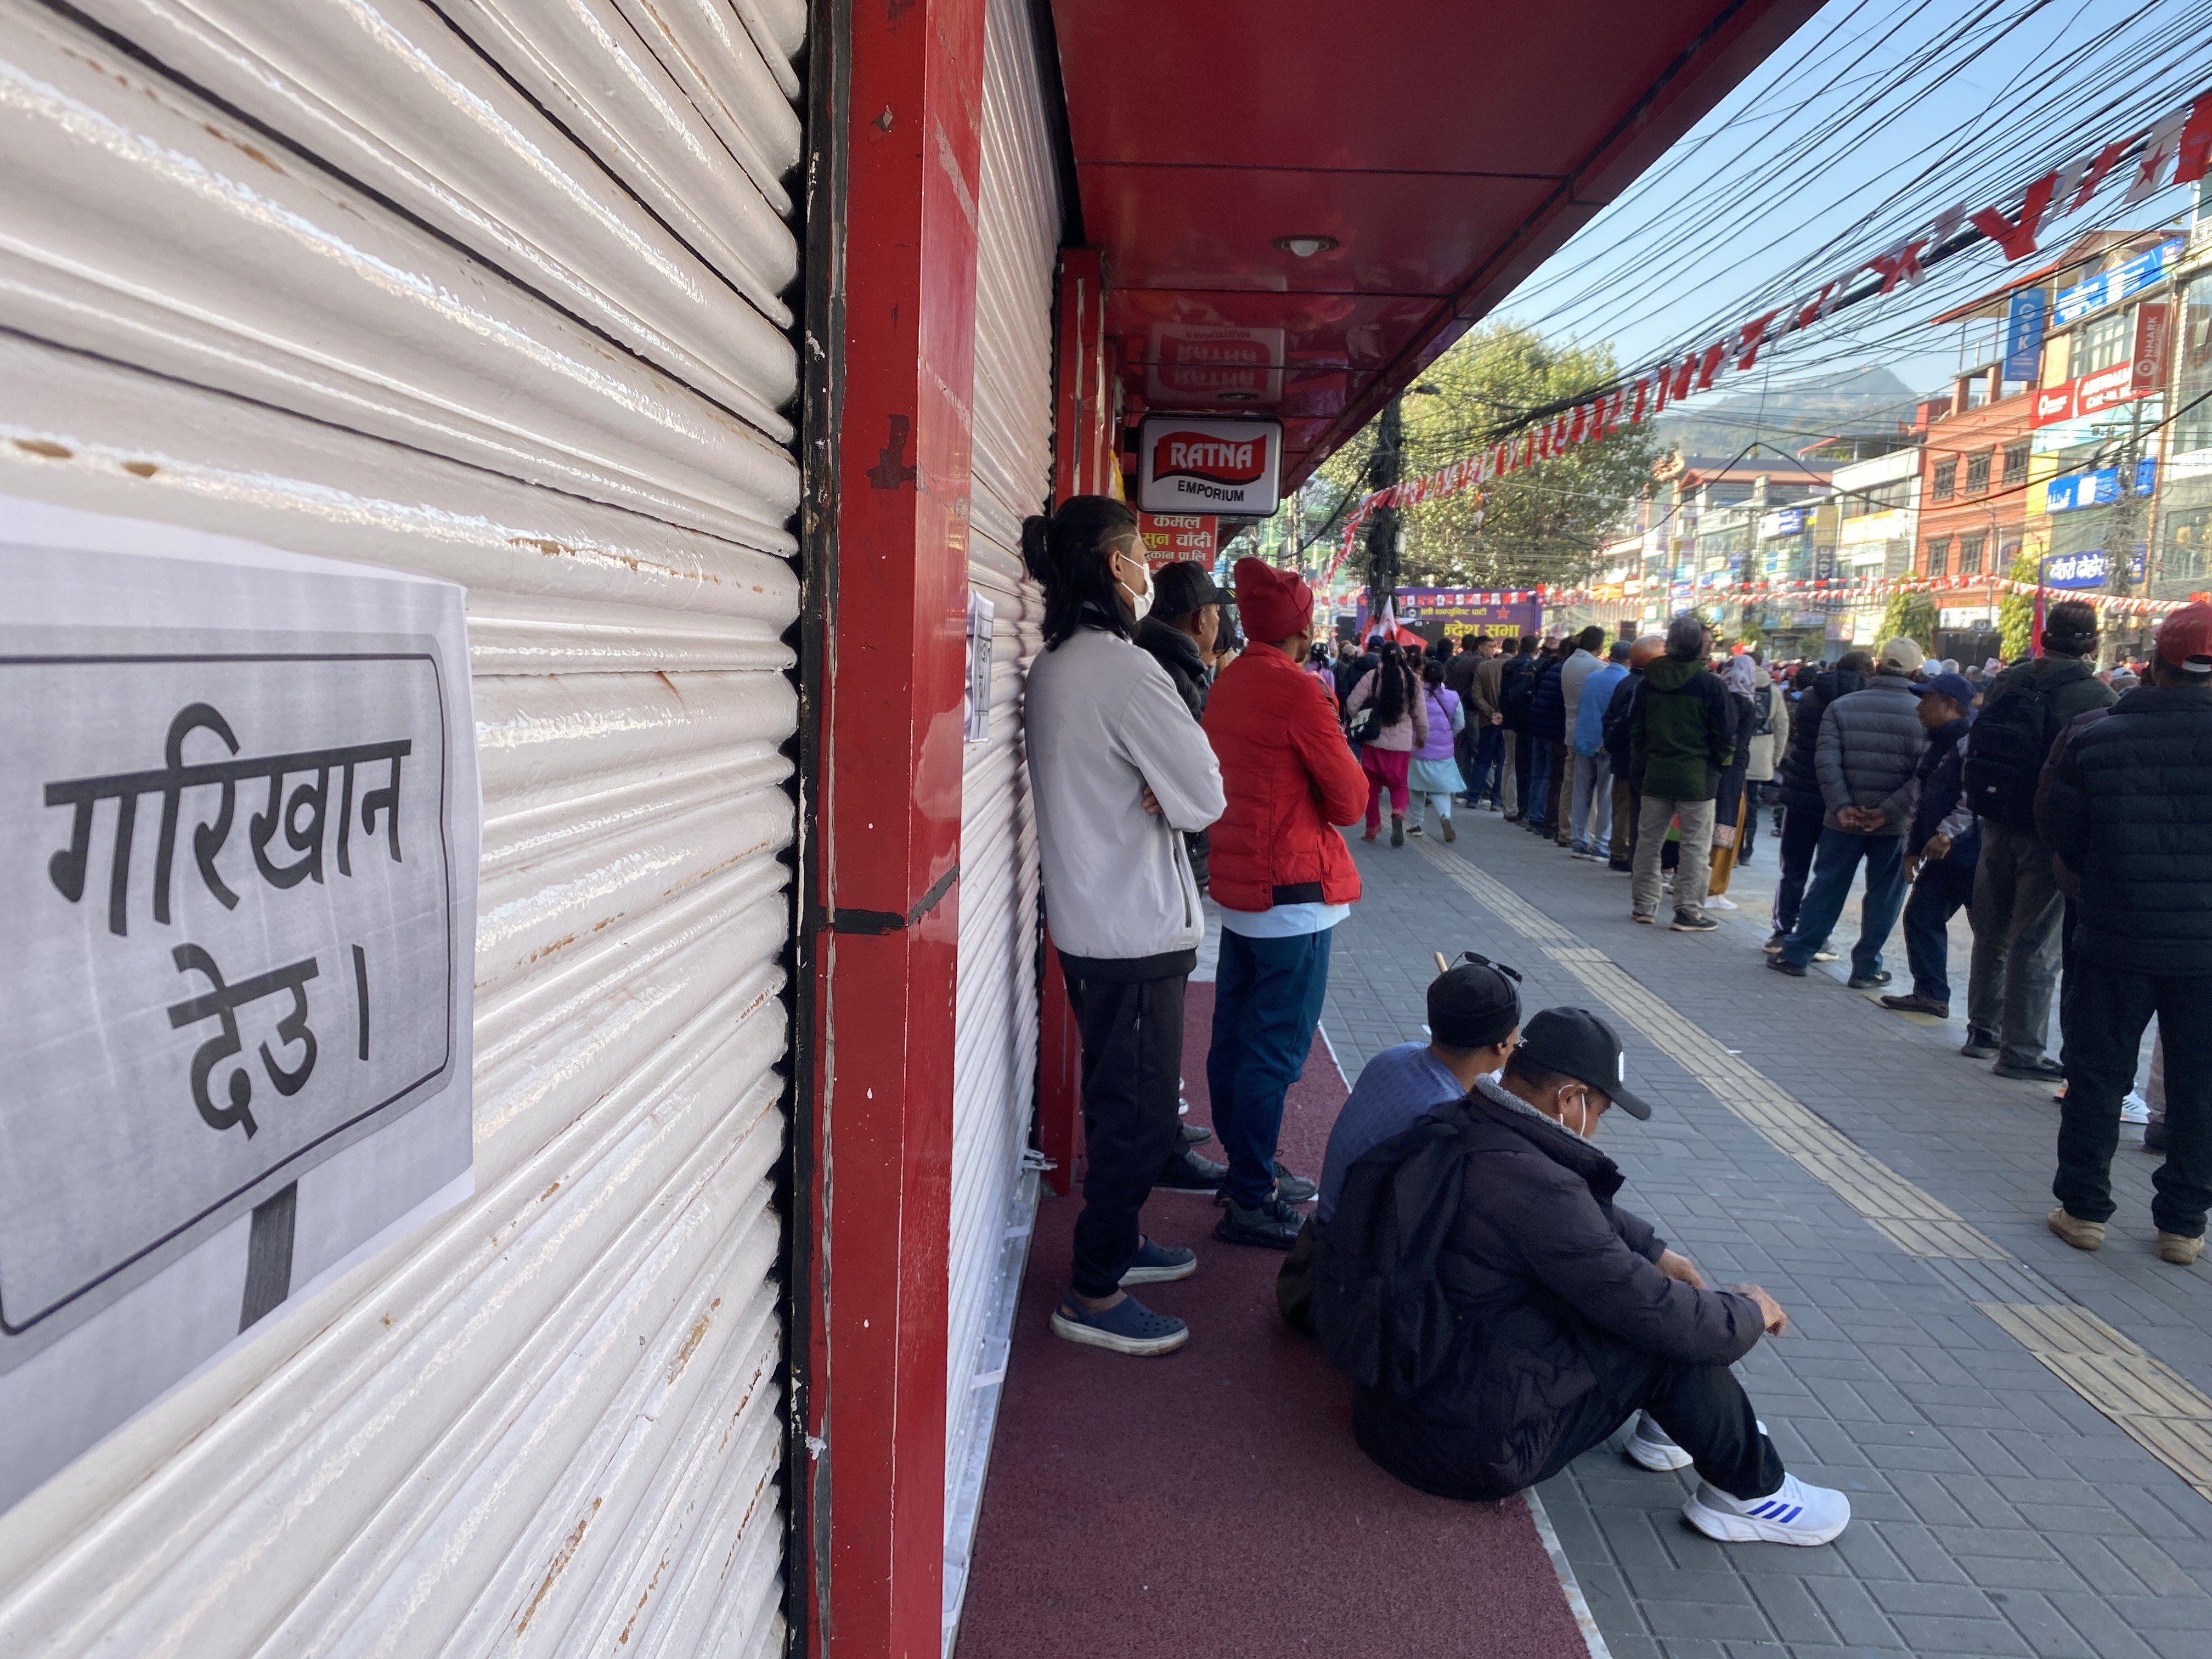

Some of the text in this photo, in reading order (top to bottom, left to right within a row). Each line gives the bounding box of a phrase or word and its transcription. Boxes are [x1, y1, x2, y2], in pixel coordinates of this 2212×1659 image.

[1171, 442, 1253, 470] RATNA
[1178, 480, 1244, 501] EMPORIUM
[1153, 515, 1201, 529] कमल
[1142, 531, 1212, 549] सुन चाँदी
[1485, 624, 1521, 637] सभा
[43, 701, 413, 936] गरिखान
